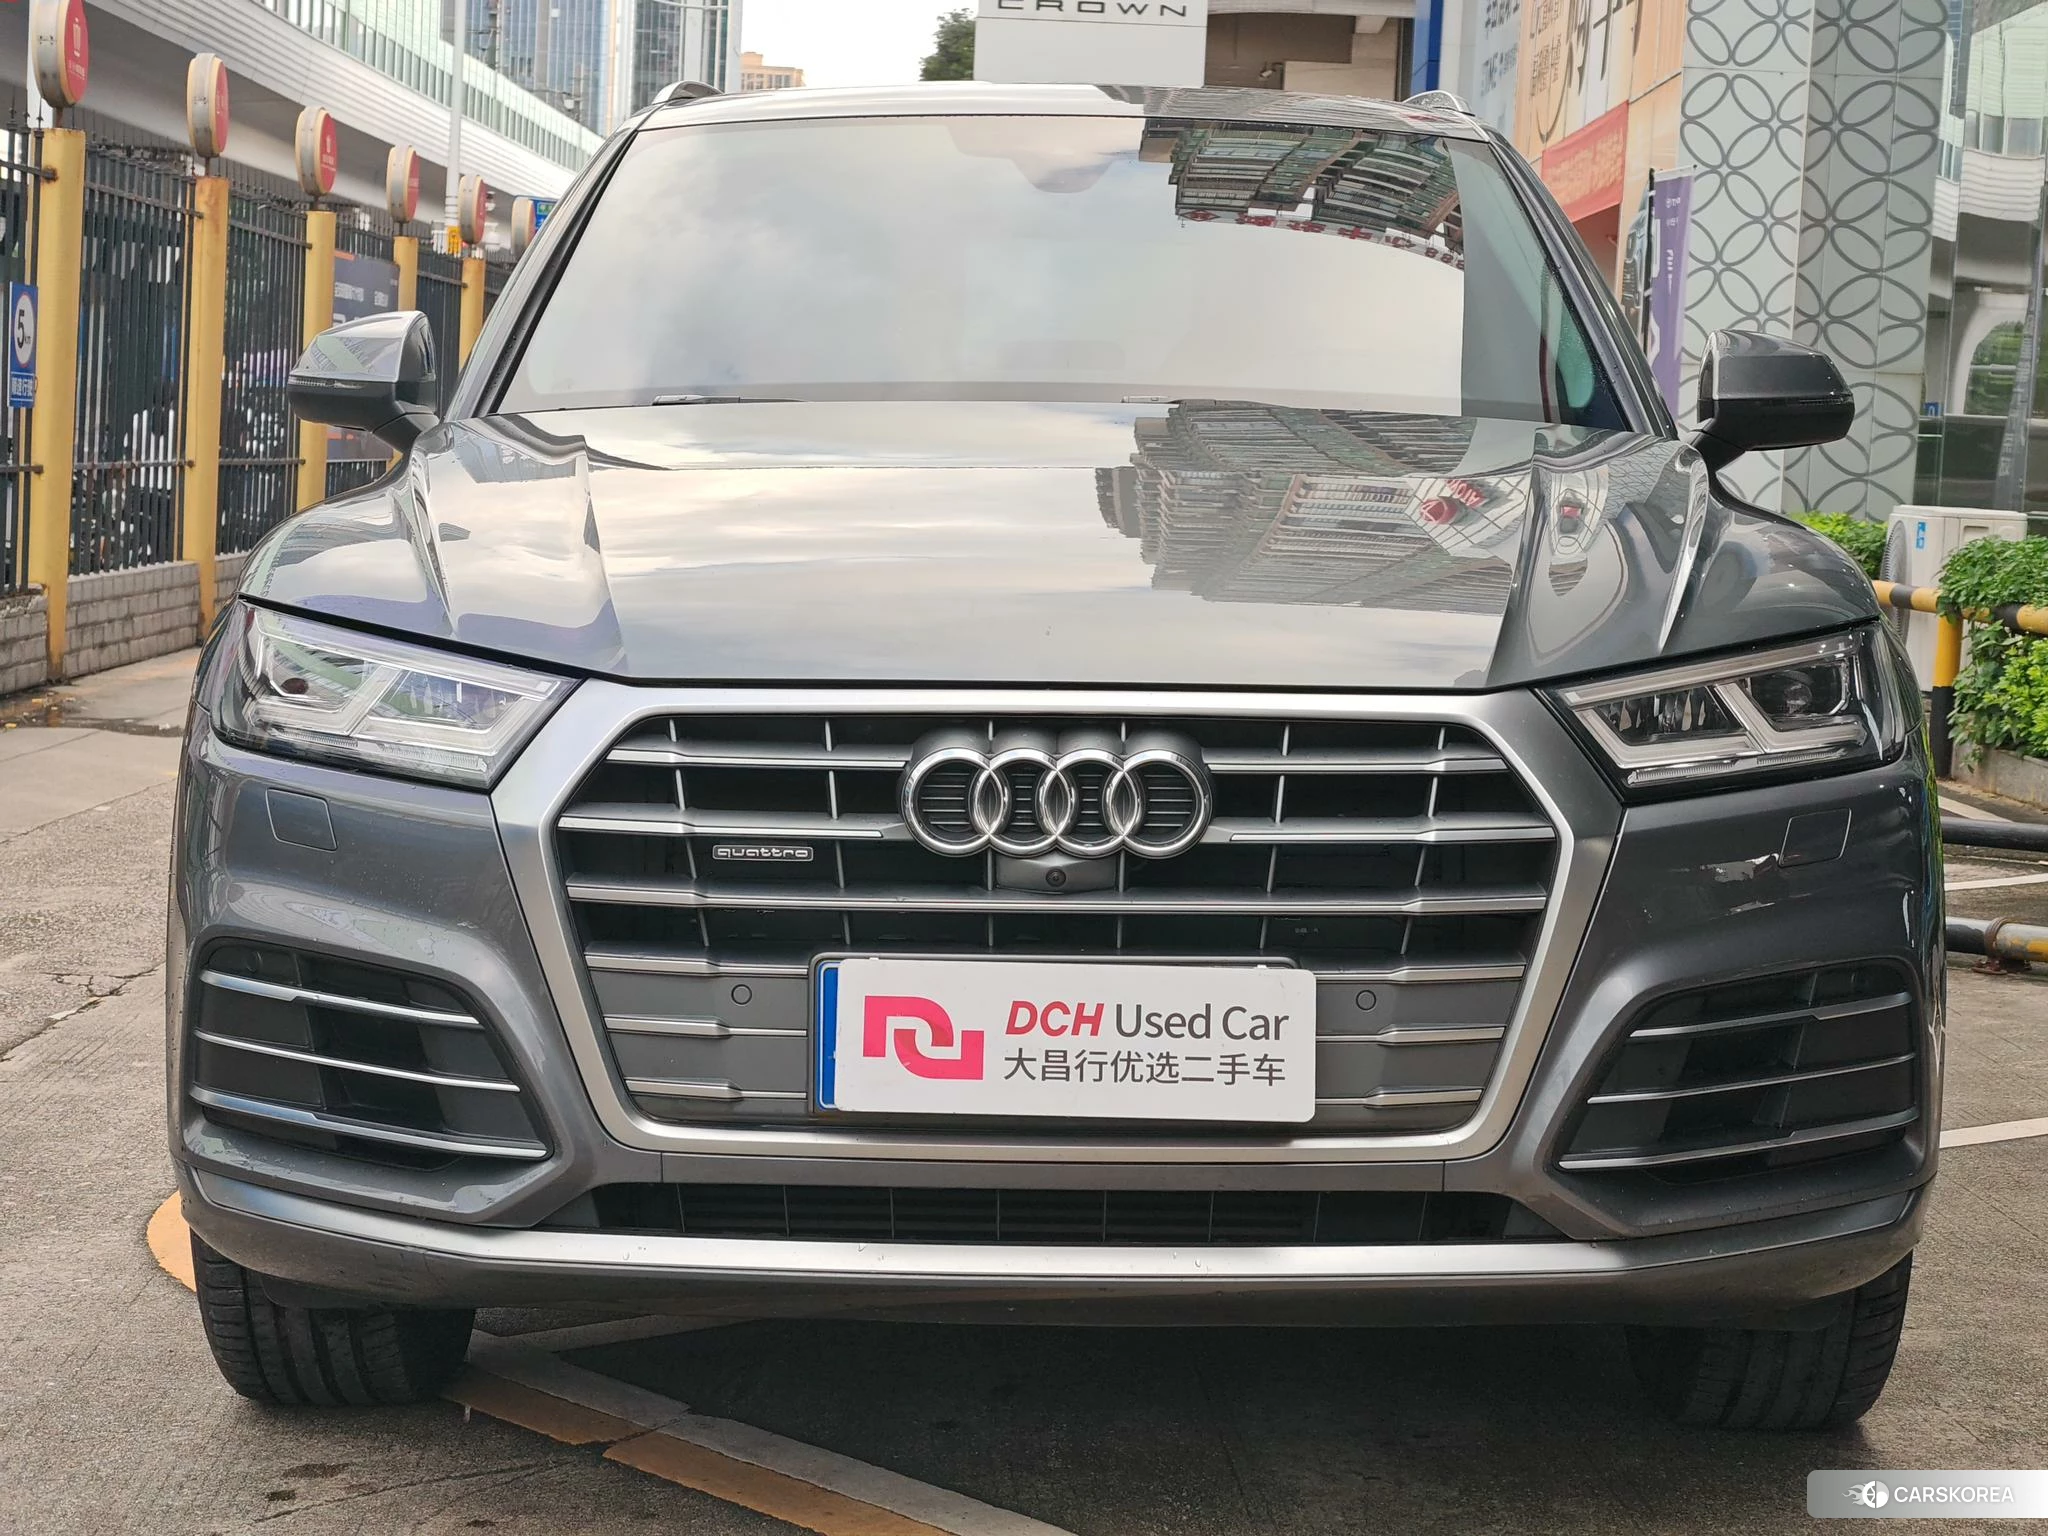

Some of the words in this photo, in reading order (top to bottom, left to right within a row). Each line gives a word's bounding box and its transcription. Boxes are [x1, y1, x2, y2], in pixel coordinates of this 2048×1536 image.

[998, 0, 1186, 17] CROWN
[718, 847, 808, 858] quattro
[1005, 1000, 1104, 1037] DCH
[1115, 1003, 1211, 1039] Used
[1222, 1005, 1289, 1041] Car
[1004, 1047, 1285, 1086] 大昌行优选二手车
